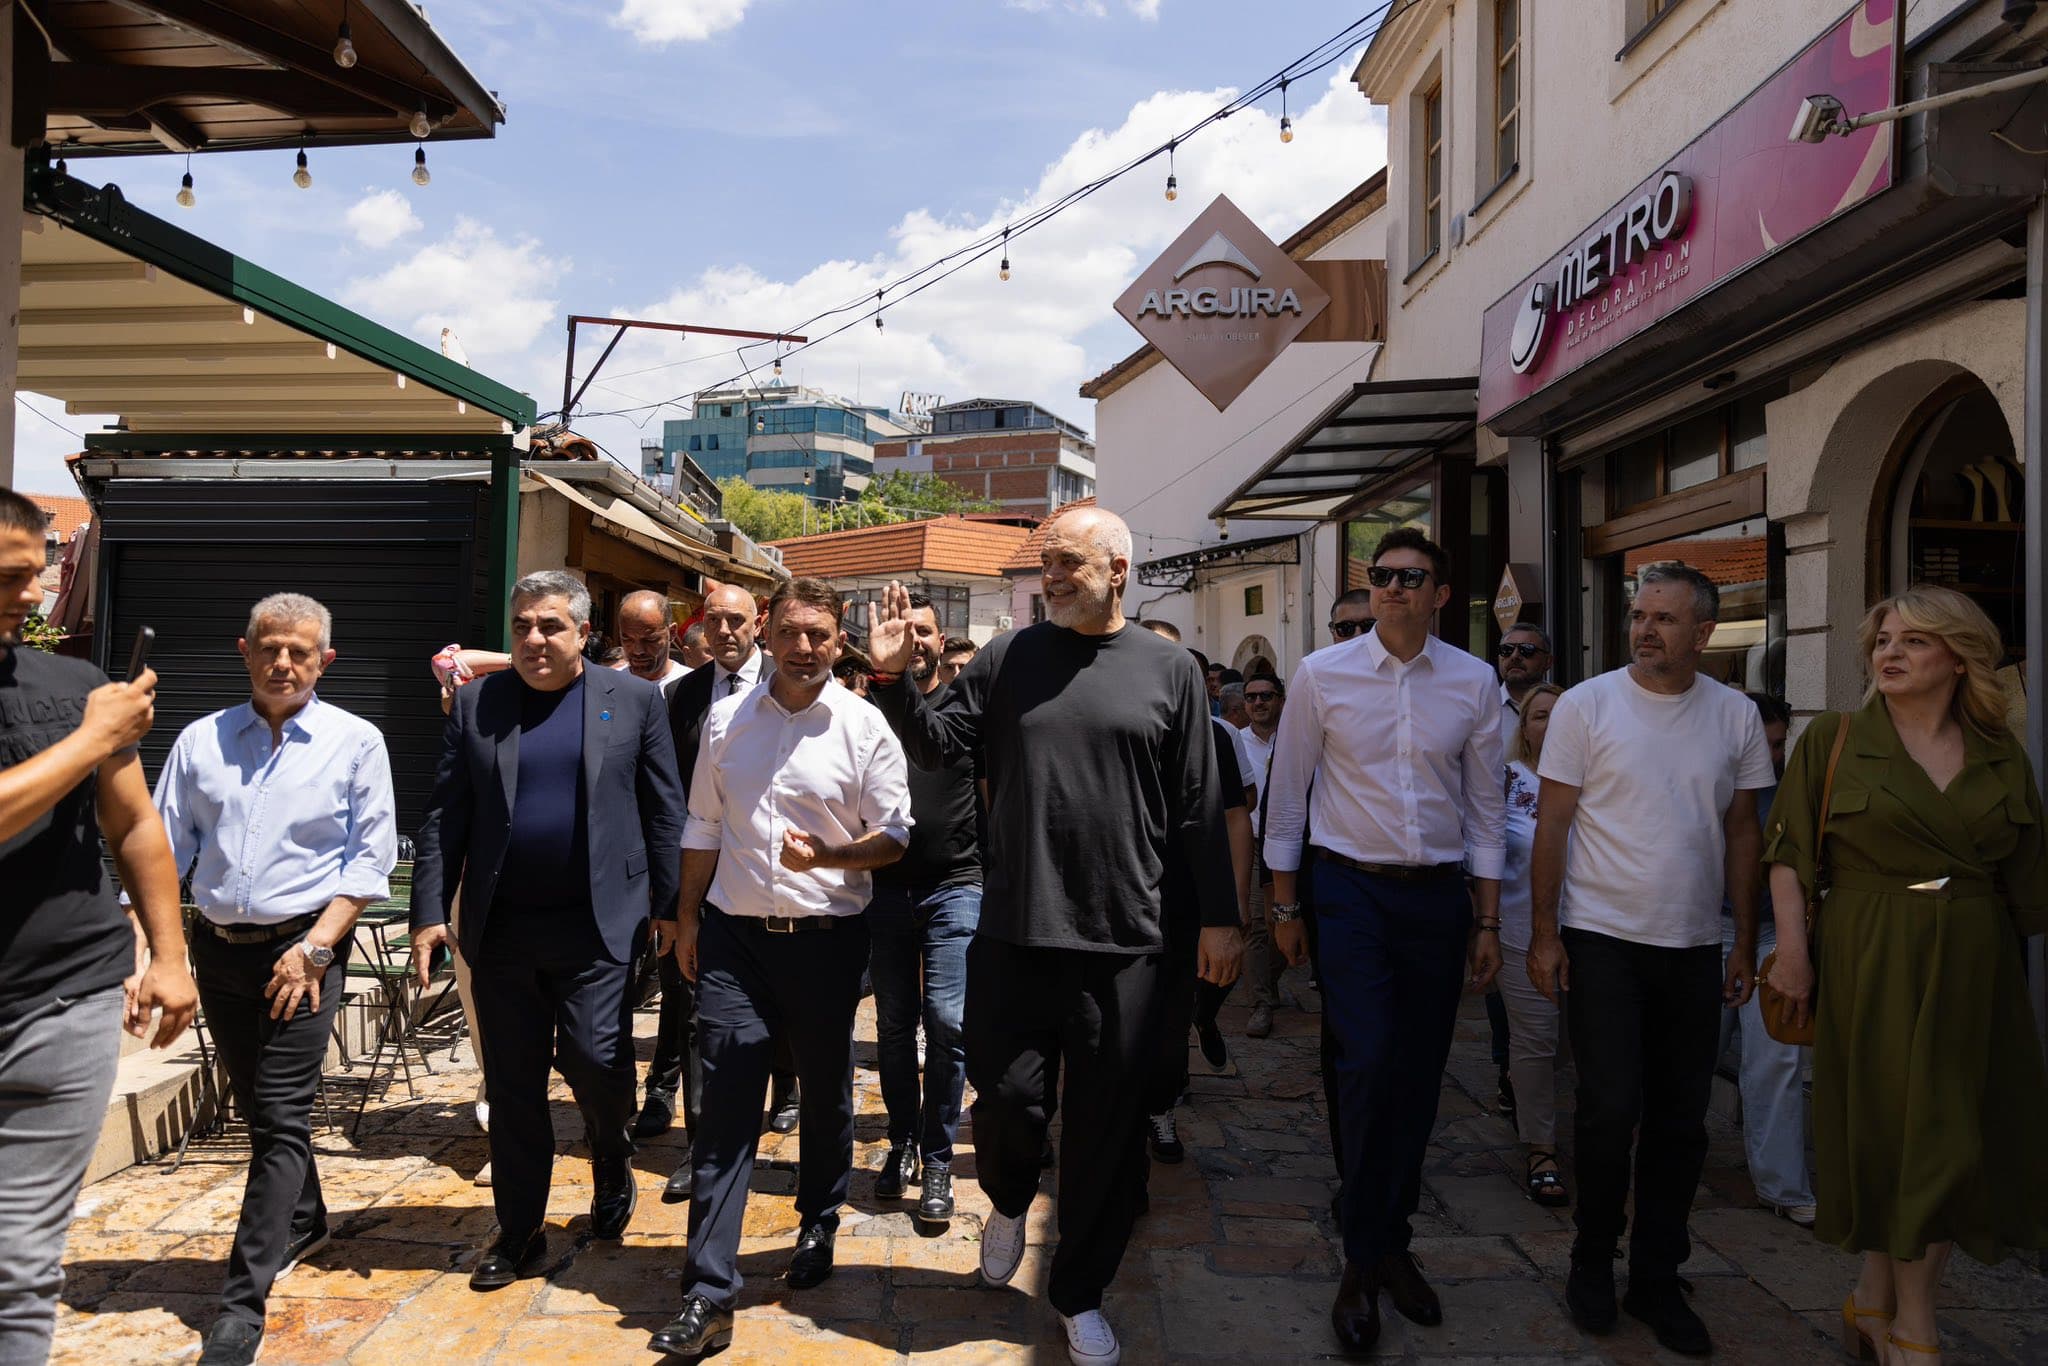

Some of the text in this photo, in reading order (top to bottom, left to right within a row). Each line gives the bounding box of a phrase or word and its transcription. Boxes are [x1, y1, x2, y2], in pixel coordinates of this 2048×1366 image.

[1556, 173, 1684, 312] METRO
[1568, 240, 1690, 336] DECORATION
[1137, 286, 1302, 317] ARGJIRA
